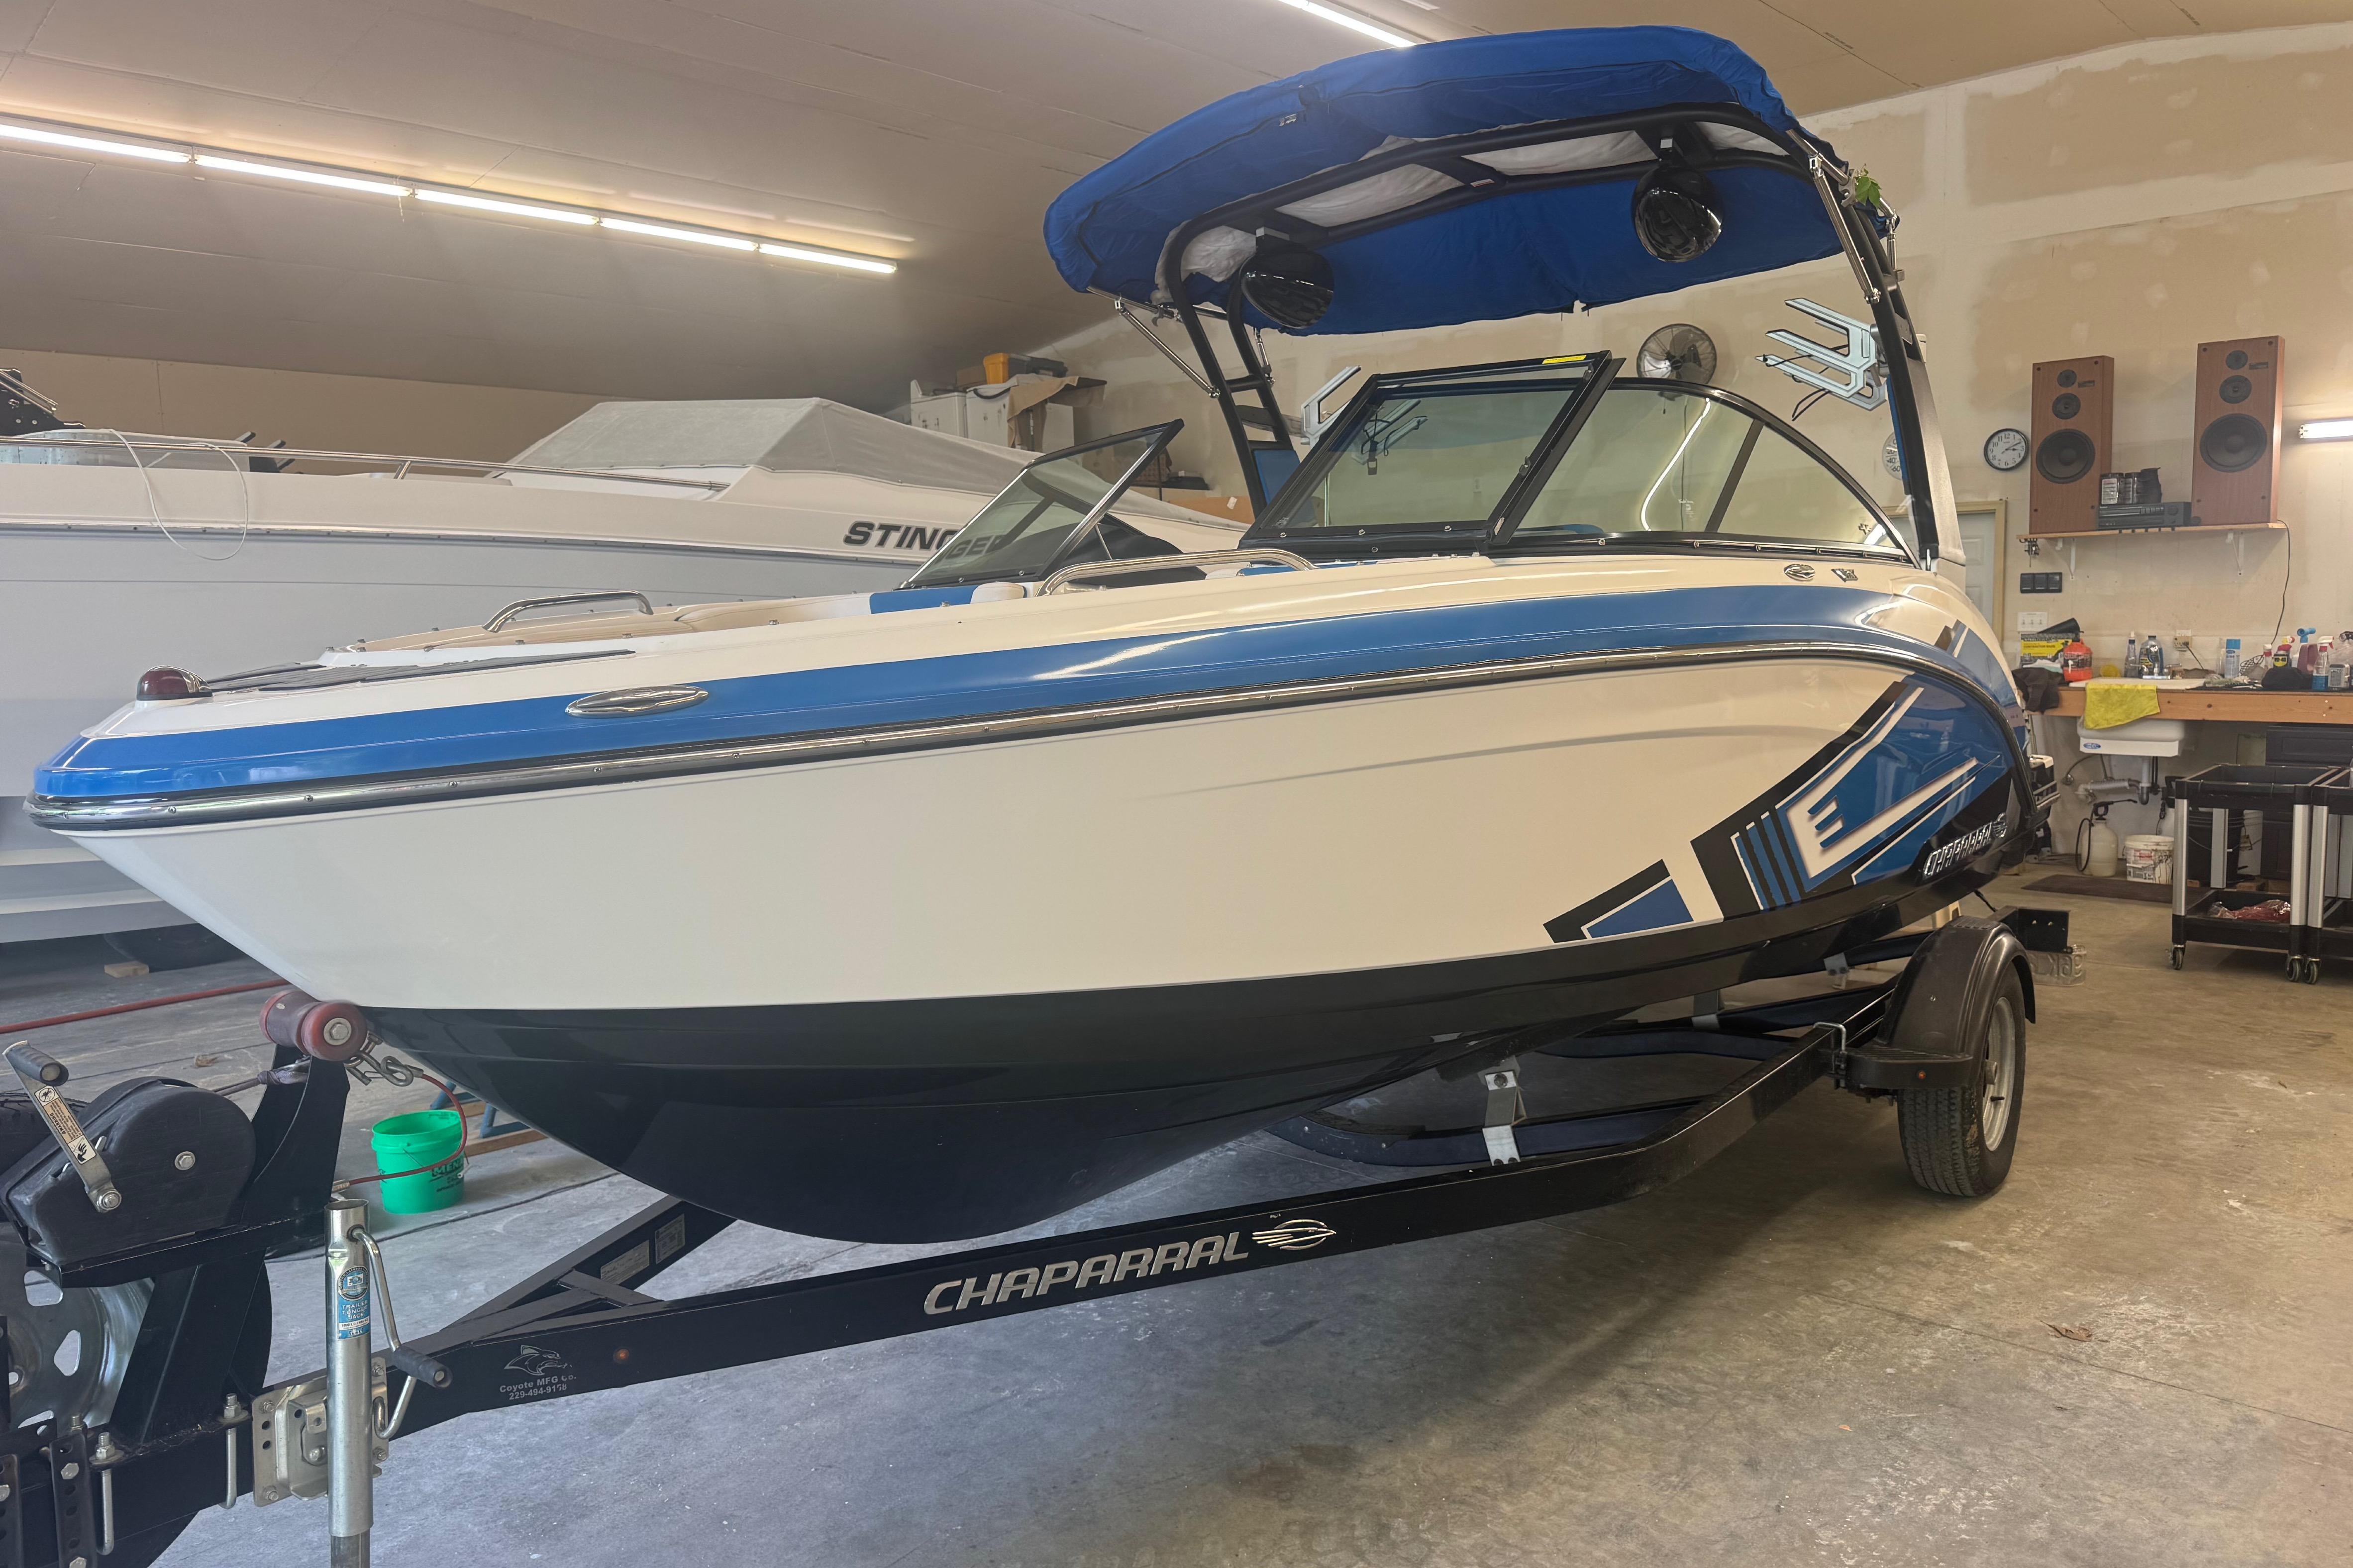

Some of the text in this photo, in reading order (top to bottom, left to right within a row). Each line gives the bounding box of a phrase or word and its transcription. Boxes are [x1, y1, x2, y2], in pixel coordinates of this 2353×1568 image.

[924, 1232, 1249, 1315] CHAPARRAL
[342, 1300, 368, 1310] TRAILER
[342, 1305, 367, 1315] TONGUE
[349, 1311, 365, 1320] JACK
[500, 1381, 534, 1392] Coyote
[537, 1376, 558, 1386] MFG
